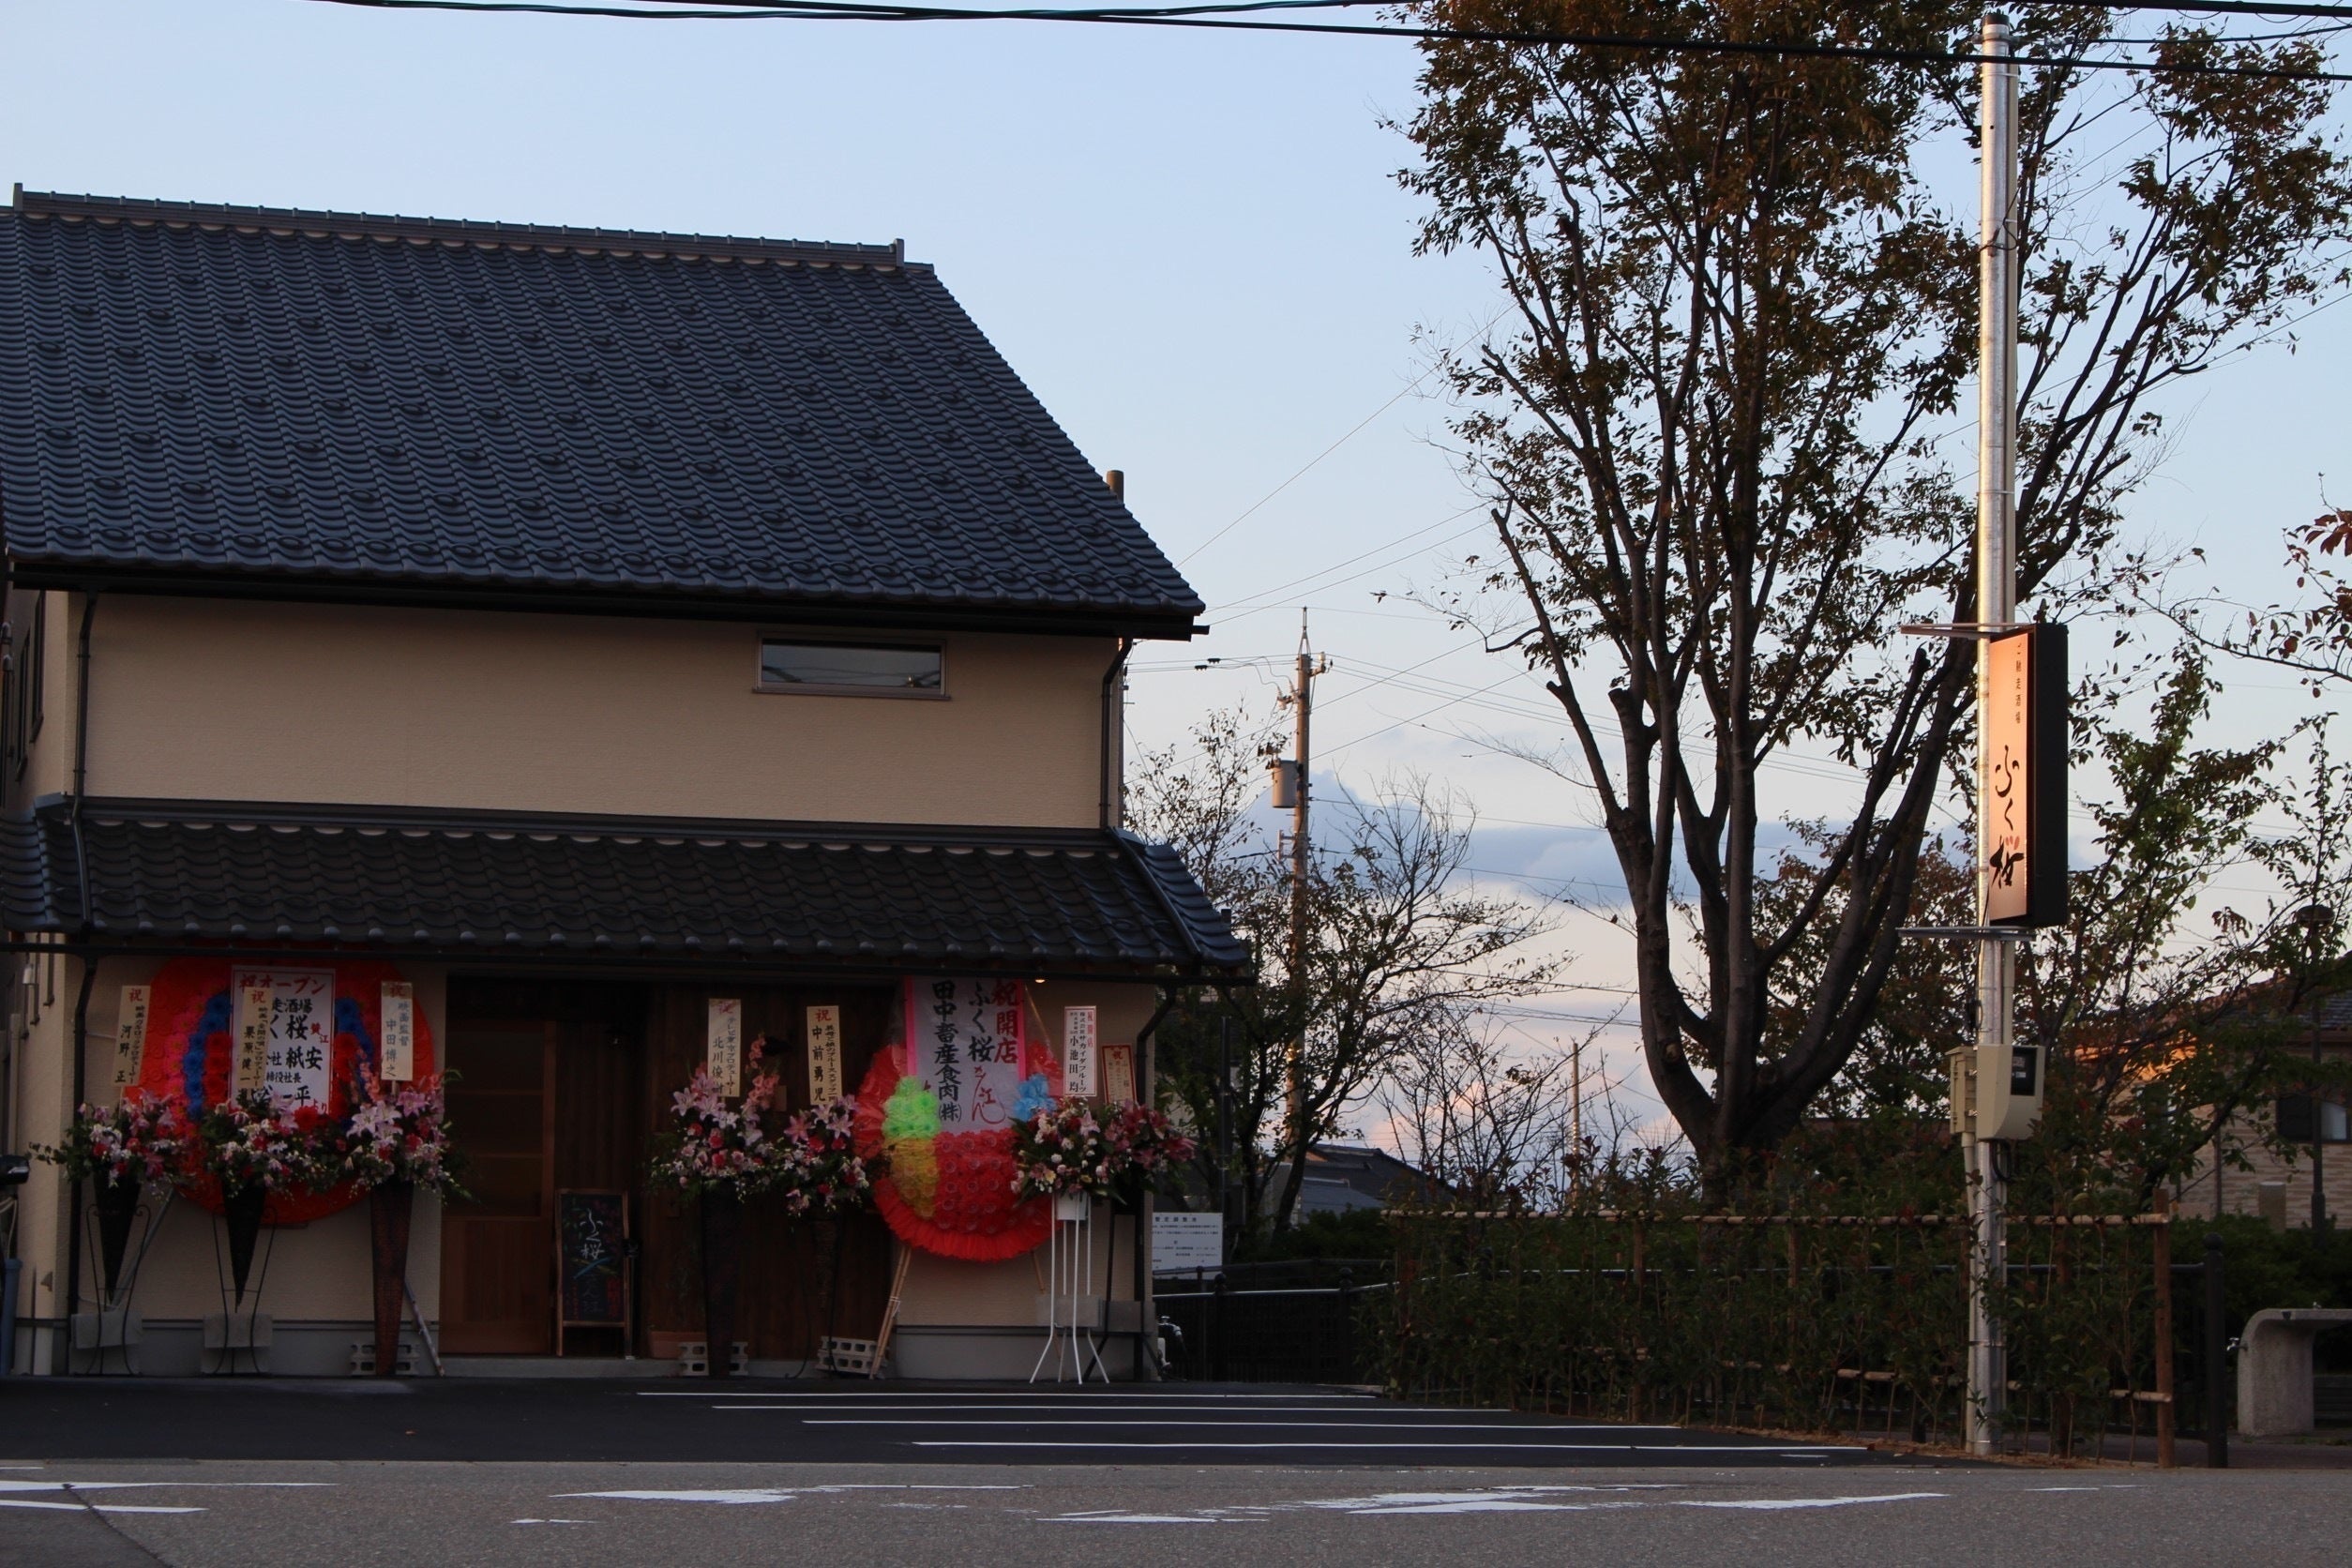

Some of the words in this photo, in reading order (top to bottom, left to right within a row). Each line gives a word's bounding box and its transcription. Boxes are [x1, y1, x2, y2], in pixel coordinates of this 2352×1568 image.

[1989, 744, 2025, 890] ふく桜
[129, 988, 143, 1002] 祝
[251, 989, 265, 1004] 祝
[389, 986, 406, 998] 祝
[398, 1001, 410, 1047] 映画監督
[815, 1009, 832, 1022] 祝
[968, 981, 996, 1063] ふく桜
[991, 977, 1024, 1064] 祝開店
[811, 1025, 826, 1102] 中前勇児
